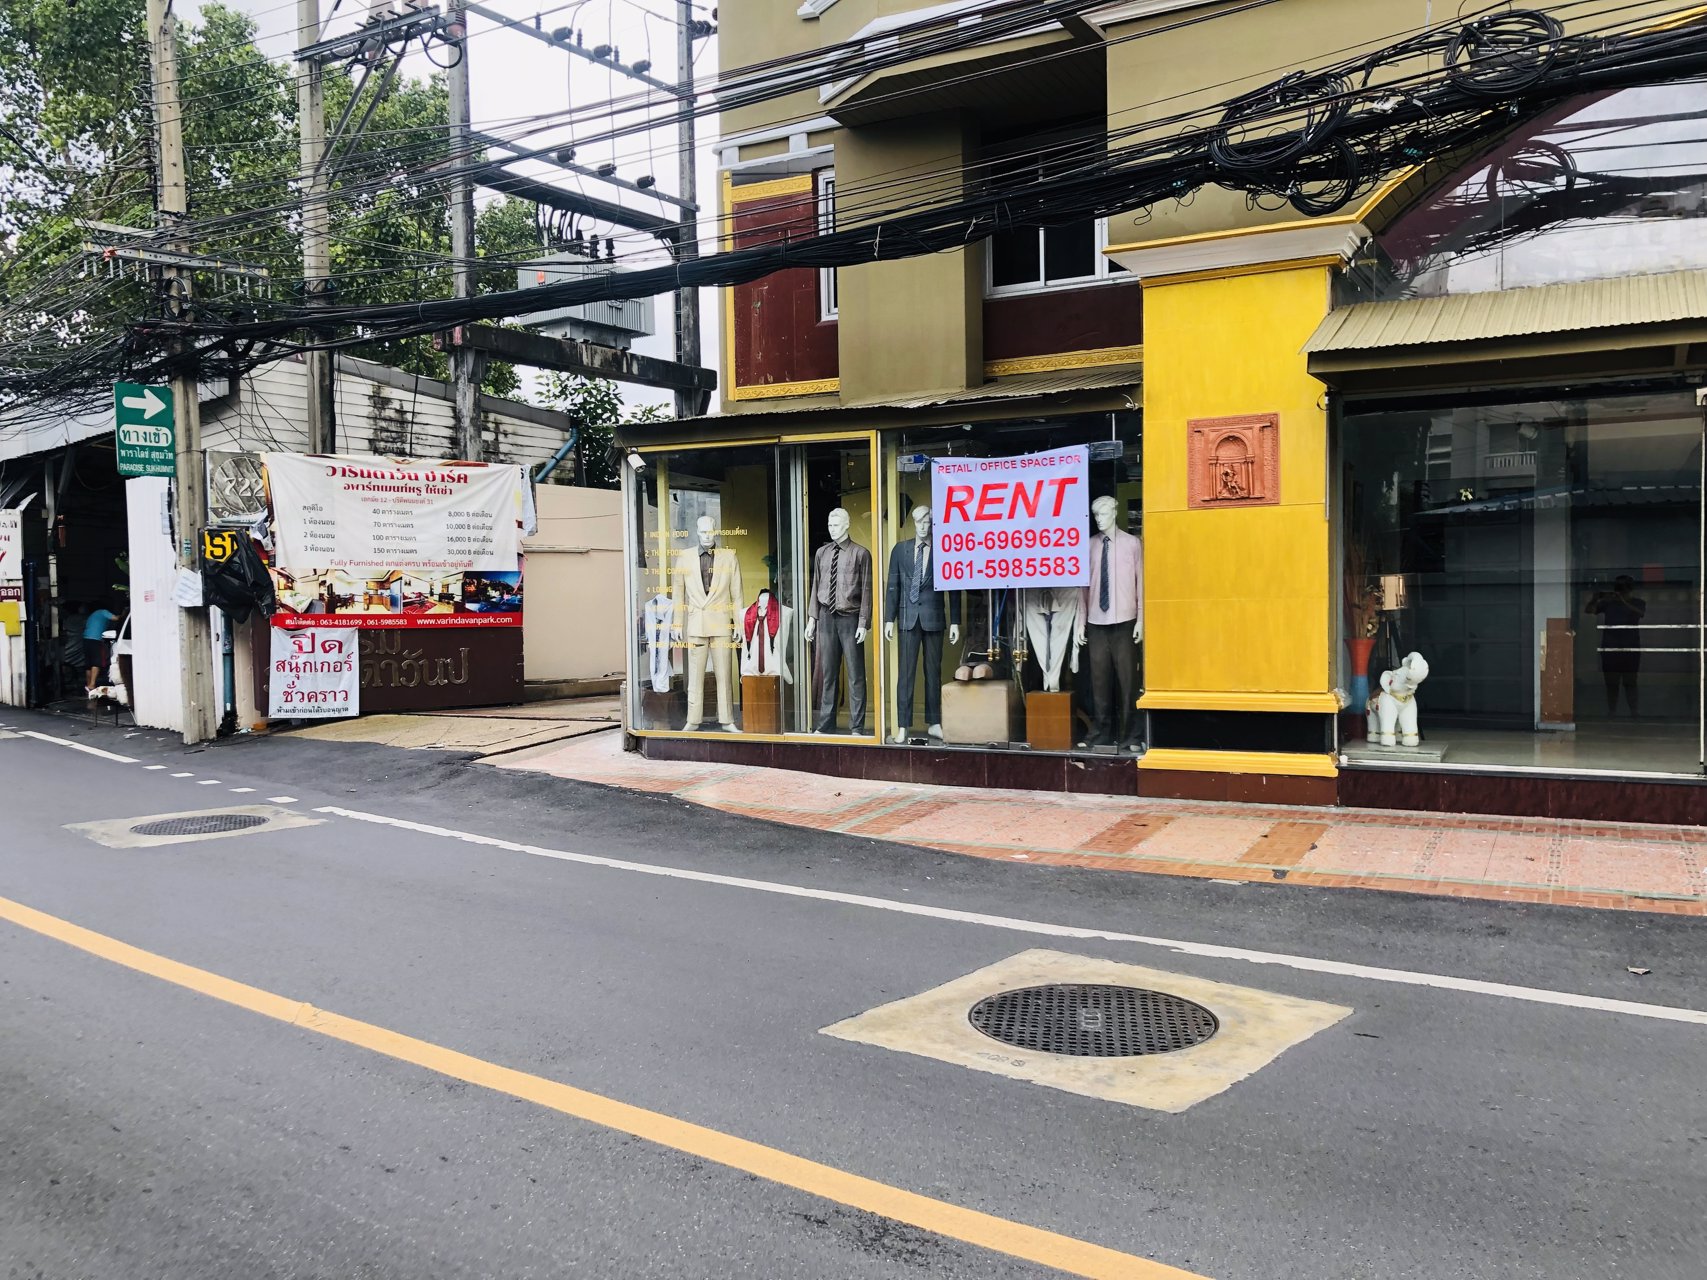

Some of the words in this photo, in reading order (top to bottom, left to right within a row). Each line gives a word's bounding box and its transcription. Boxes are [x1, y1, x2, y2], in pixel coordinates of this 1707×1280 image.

[122, 427, 169, 445] ทางเข้า
[120, 447, 149, 459] พาราไดซ์
[150, 449, 174, 462] สุขุมวิท
[120, 463, 145, 472] PARADISE
[145, 464, 174, 474] SUKHUMVIT
[937, 464, 972, 474] RETAIL
[980, 460, 1018, 471] OFFICE
[1020, 457, 1056, 468] SPACE
[1059, 455, 1081, 465] FOR
[943, 477, 1078, 524] RENT
[308, 517, 335, 526] ห้องนอน
[446, 523, 466, 531] 10,000
[309, 531, 335, 539] ห้องนอน
[447, 535, 467, 543] 16,000
[941, 527, 1080, 553] 096-6969629
[309, 544, 335, 553] ห้องนอน
[447, 548, 467, 556] 30,000
[330, 559, 347, 567] Fully
[349, 559, 384, 567] Furnished
[941, 555, 1081, 581] 061-5985583
[320, 618, 362, 627] 063-4181699
[367, 618, 407, 627] 061-5985583
[417, 615, 513, 627] www.varindavanpark.com
[290, 633, 344, 654] ปิด
[275, 652, 354, 680] สนุ๊กเกอร์
[282, 680, 349, 703] ชั่วคราว
